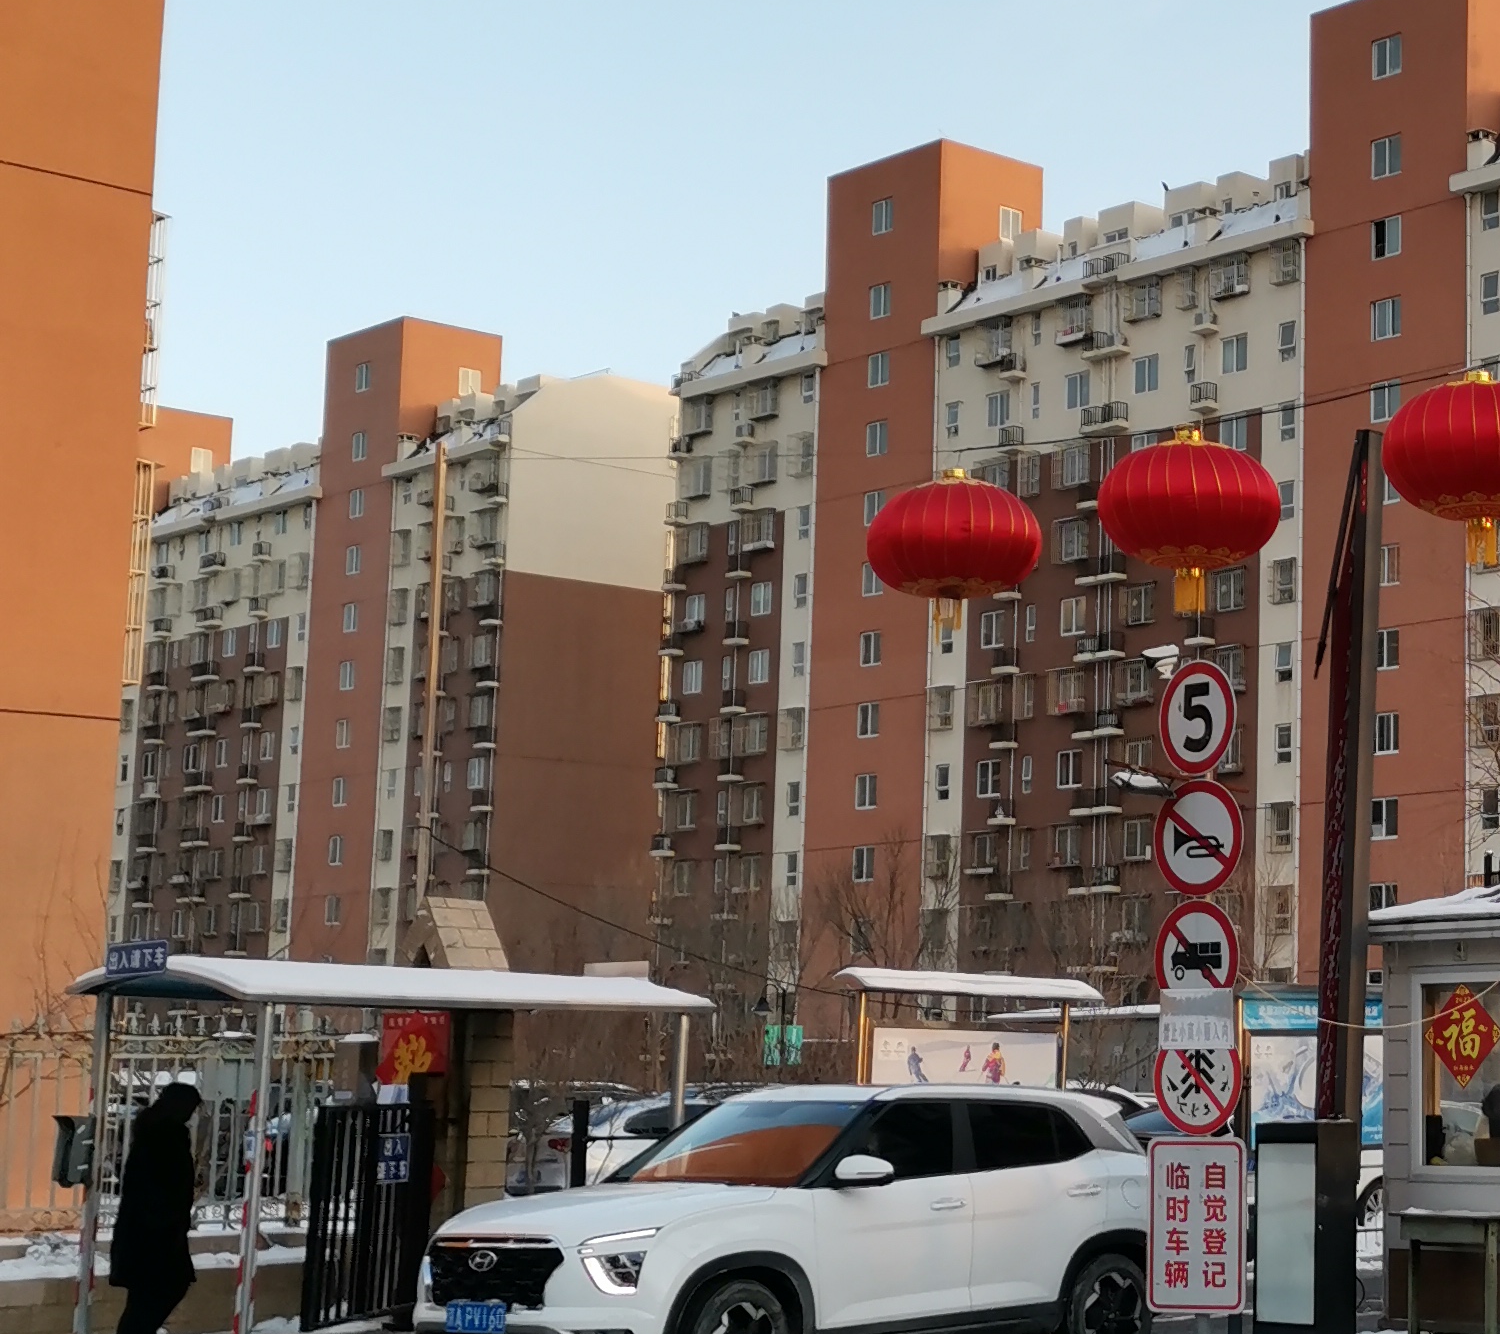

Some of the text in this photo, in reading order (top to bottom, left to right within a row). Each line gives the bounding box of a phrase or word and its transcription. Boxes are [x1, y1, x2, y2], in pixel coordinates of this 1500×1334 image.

[1183, 681, 1212, 752] 5
[108, 946, 165, 970] 出入请下车
[1442, 1008, 1481, 1061] 福
[1164, 1162, 1191, 1289] 临时车辆
[1202, 1162, 1227, 1289] 自觉登记
